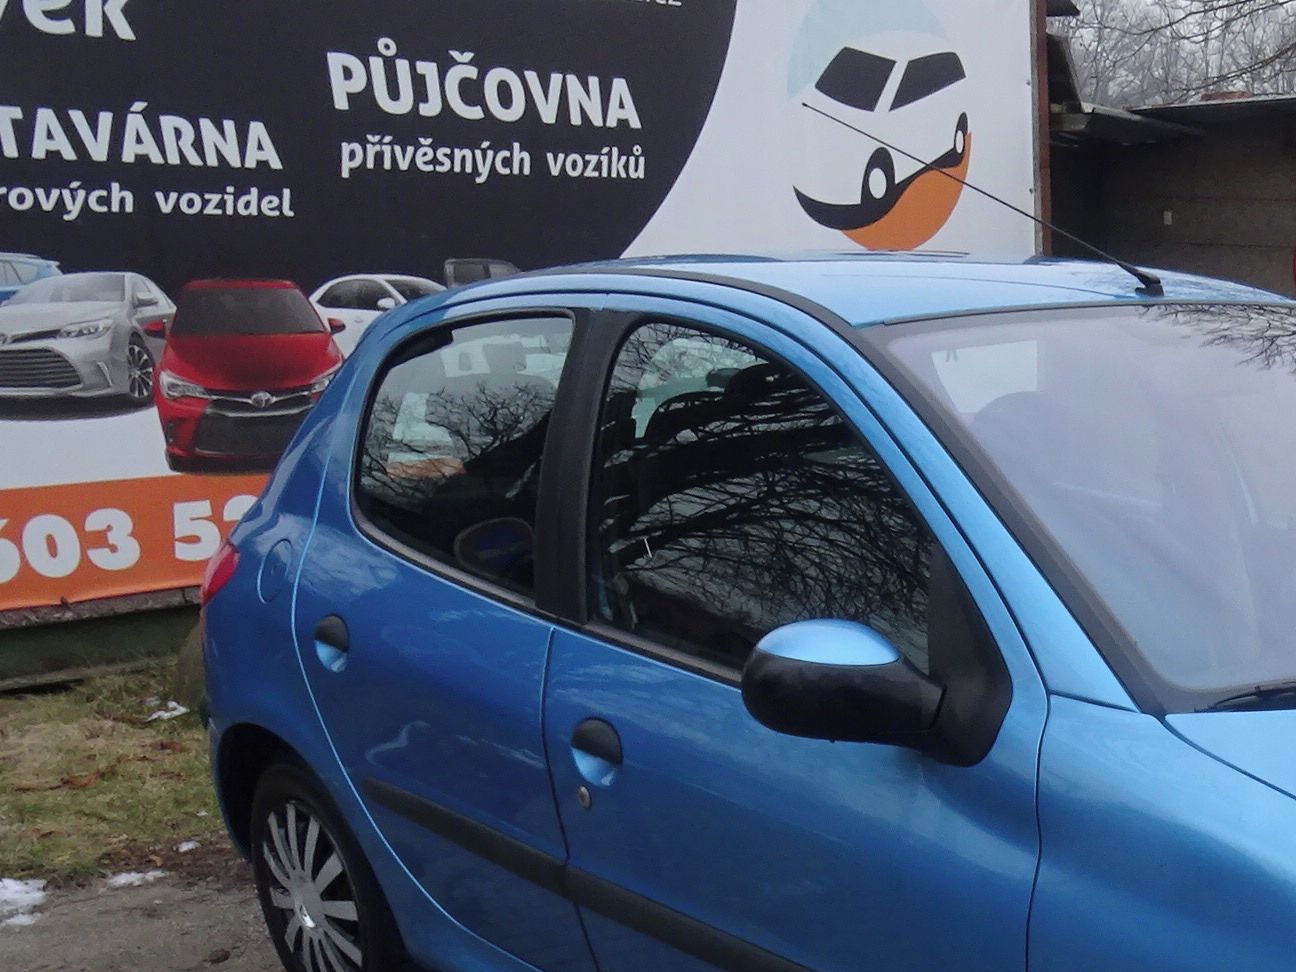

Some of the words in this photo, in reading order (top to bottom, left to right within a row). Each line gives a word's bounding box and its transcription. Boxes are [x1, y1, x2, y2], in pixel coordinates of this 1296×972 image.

[0, 0, 137, 41] ek
[327, 37, 642, 129] PŮJČOVNA
[341, 134, 531, 184] přívěsných
[546, 144, 646, 179] vozíků
[155, 186, 295, 218] vozidel
